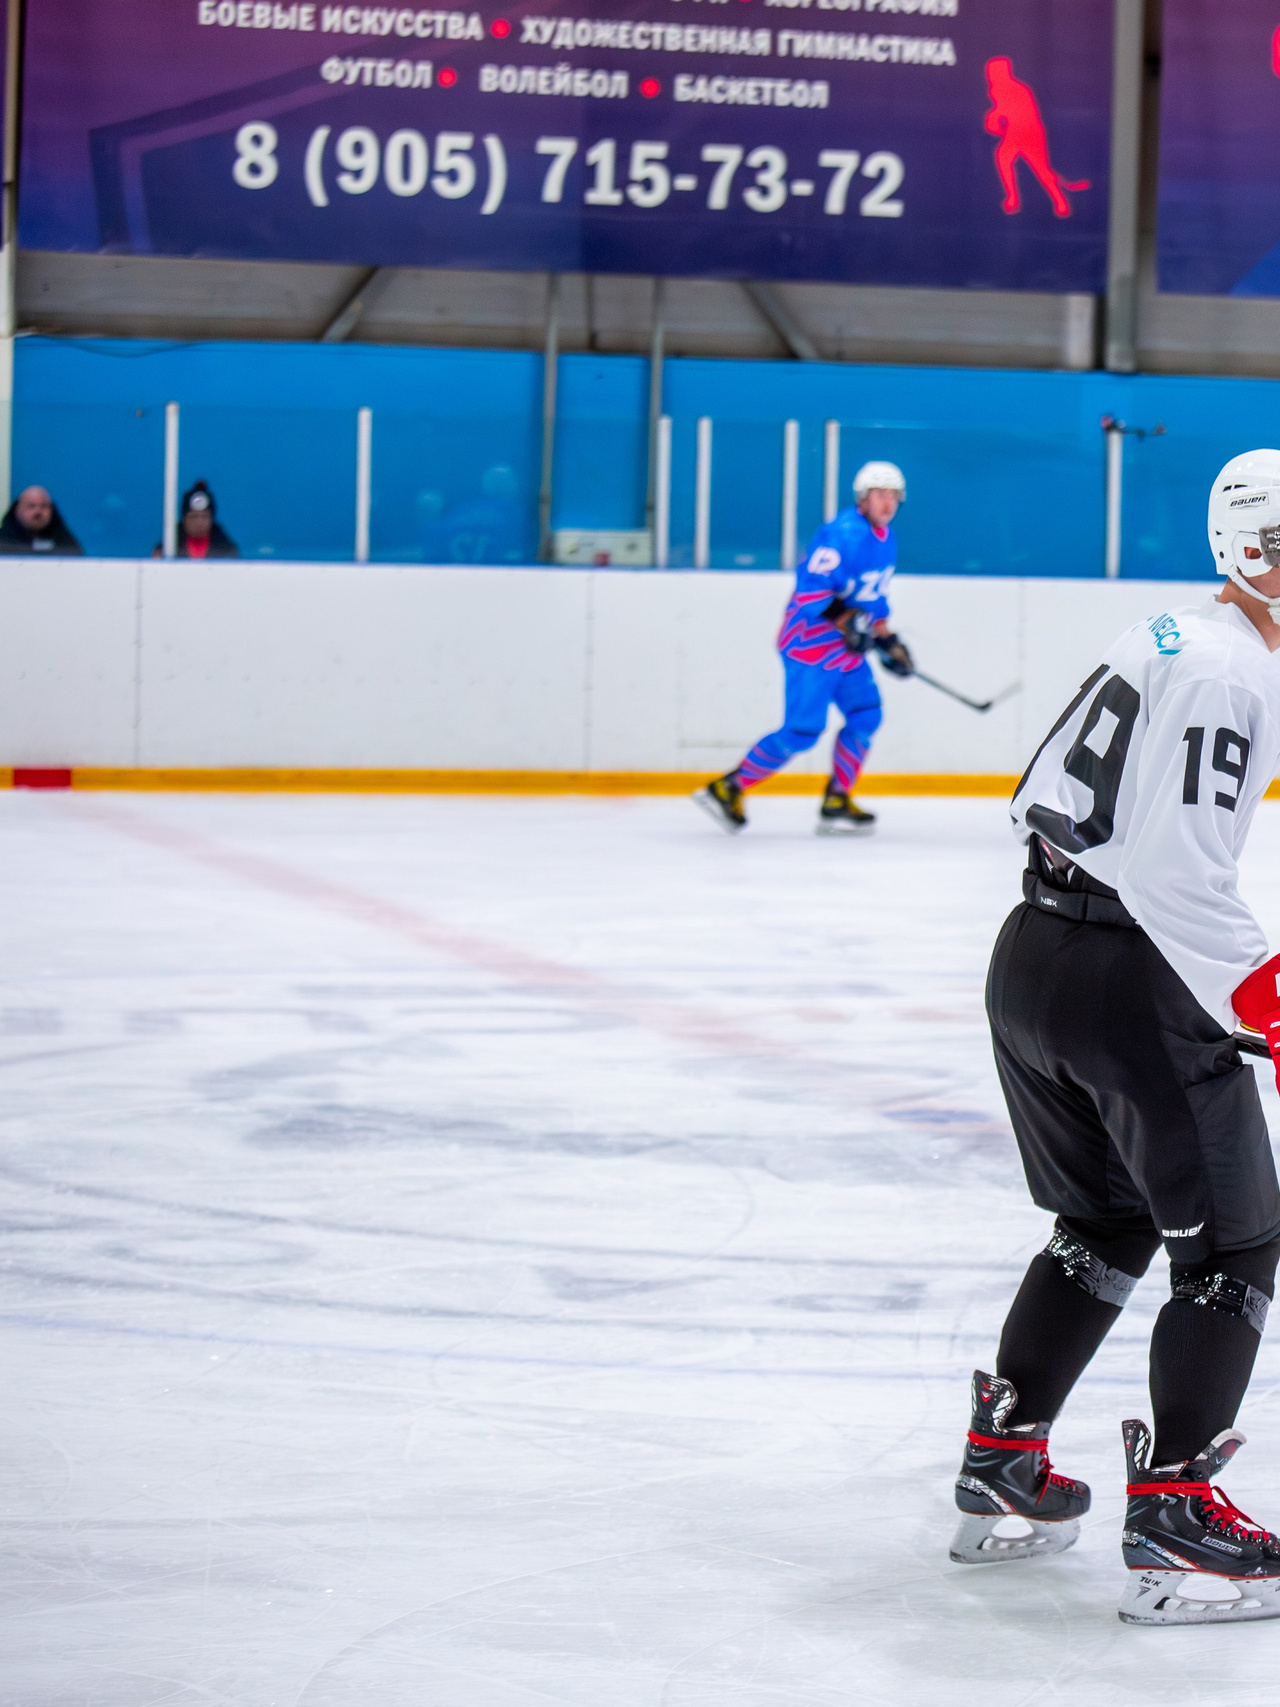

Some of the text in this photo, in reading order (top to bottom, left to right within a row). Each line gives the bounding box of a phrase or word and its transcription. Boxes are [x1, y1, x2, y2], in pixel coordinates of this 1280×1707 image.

[198, 0, 957, 66] БОЕВЫЕ ИСКУССТВА ХУДОЖЕСТВЕННАЯ ГИМНАСТИКА
[320, 56, 829, 109] ФУТБОЛ ВОЛЕЙБОЛ БАСКЕТБОЛ
[233, 122, 905, 218] 8 (905) 715-73-72
[1182, 726, 1250, 813] 19
